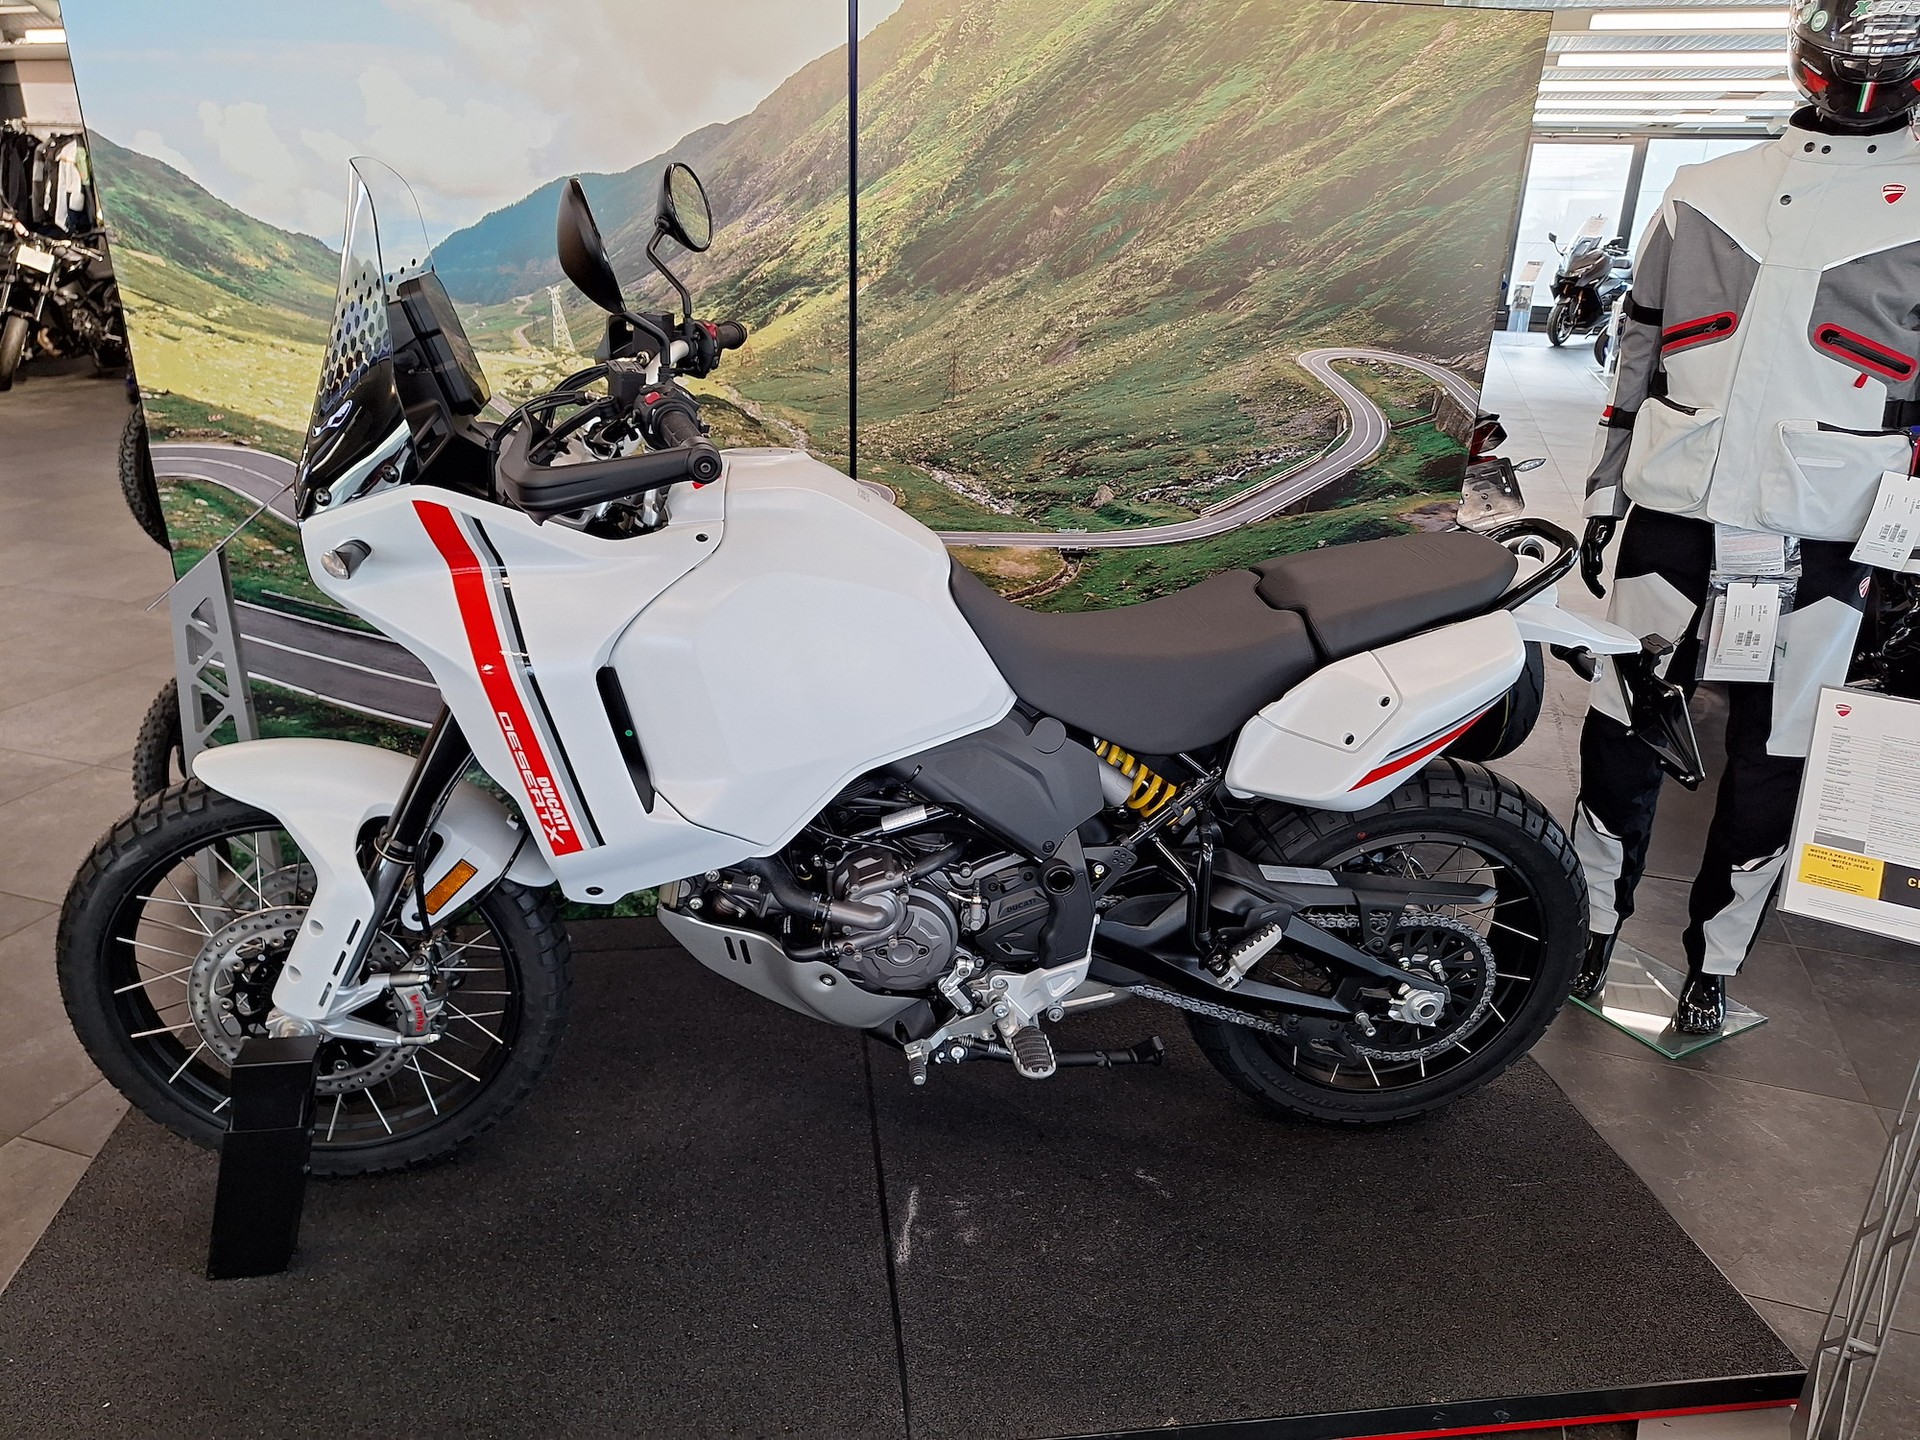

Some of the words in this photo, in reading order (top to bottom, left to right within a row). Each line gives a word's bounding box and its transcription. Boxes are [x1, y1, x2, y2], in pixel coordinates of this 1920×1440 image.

[536, 776, 570, 832] DUCATI
[1006, 898, 1037, 912] DUCATI
[409, 994, 427, 1032] brembo
